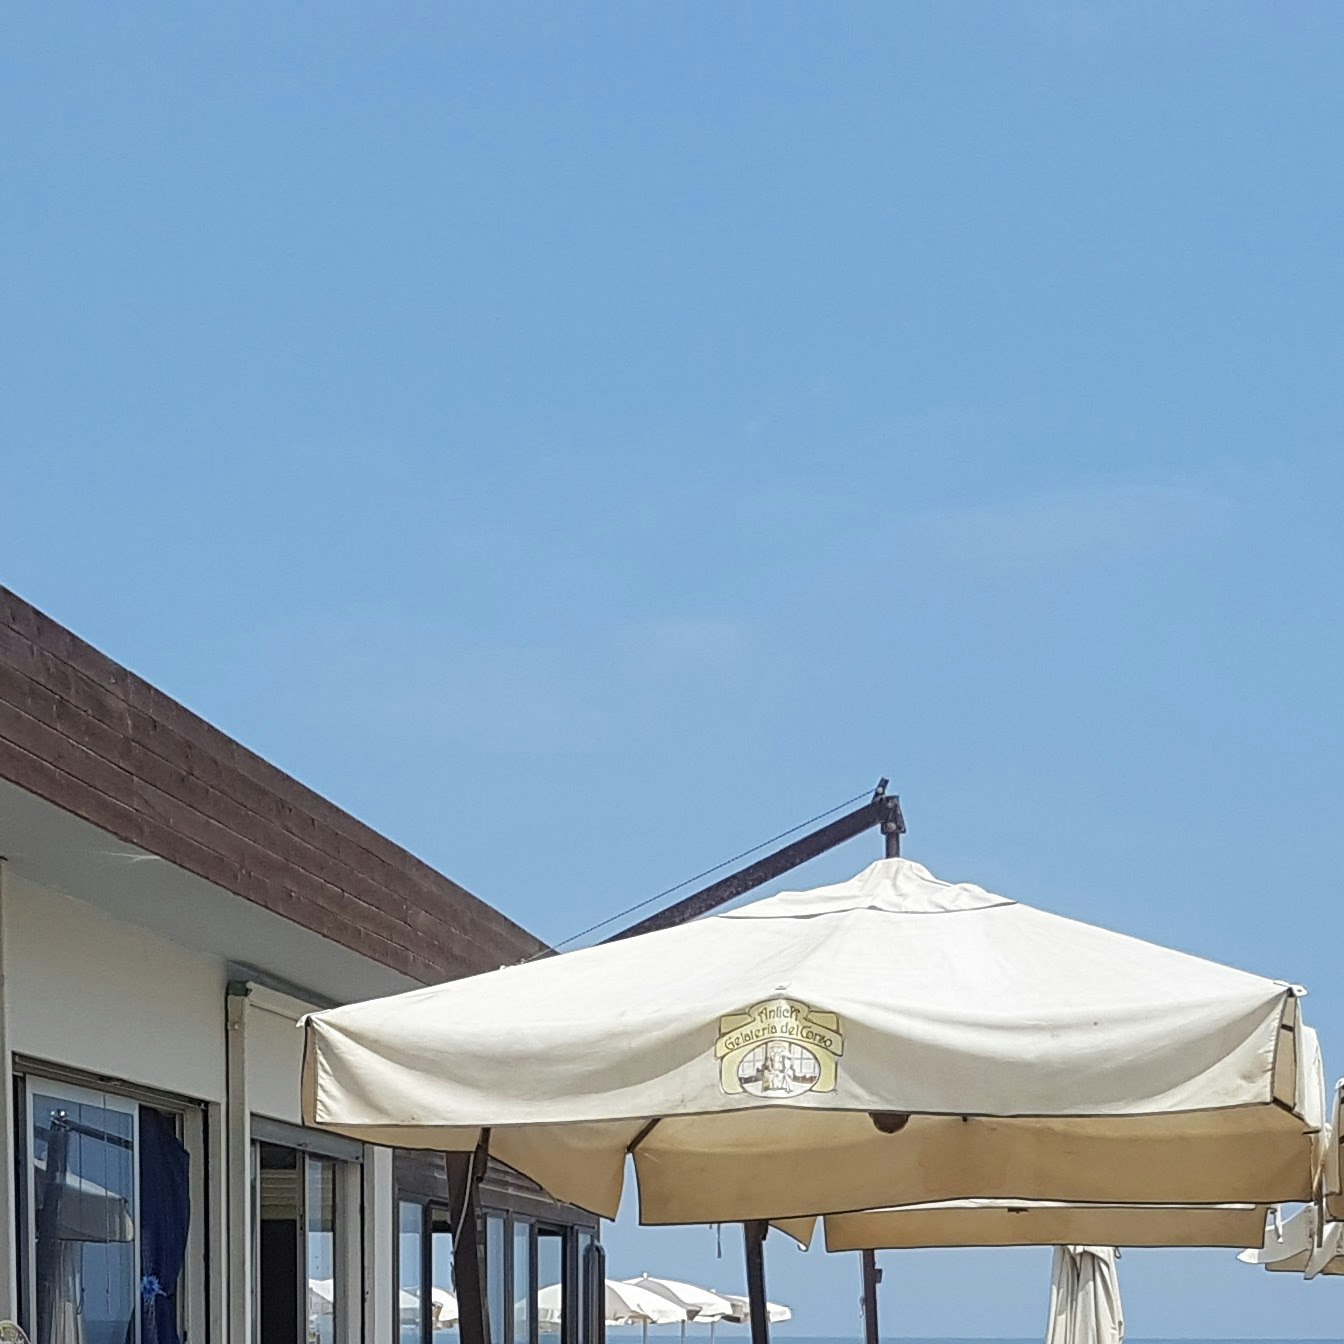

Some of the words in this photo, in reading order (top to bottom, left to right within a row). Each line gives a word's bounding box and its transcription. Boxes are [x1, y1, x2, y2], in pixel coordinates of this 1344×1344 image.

[724, 1024, 777, 1050] Gelateria
[780, 1022, 799, 1038] del
[800, 1025, 832, 1048] Corso
